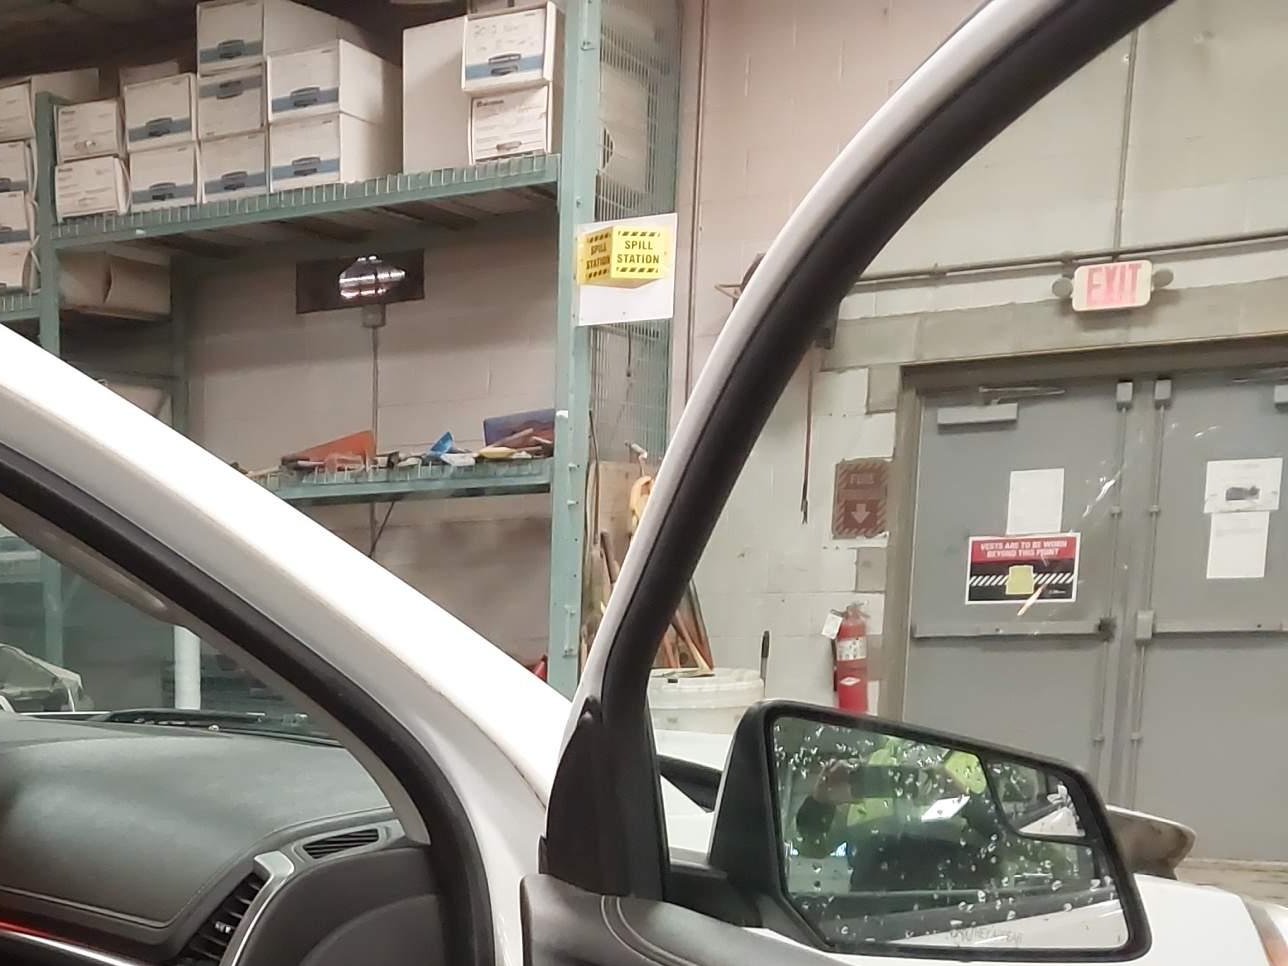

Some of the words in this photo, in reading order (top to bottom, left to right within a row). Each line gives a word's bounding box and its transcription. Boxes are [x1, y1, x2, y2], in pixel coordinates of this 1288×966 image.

[591, 242, 607, 256] SPILL
[624, 240, 653, 250] SPILL
[586, 256, 610, 270] STATION
[616, 253, 660, 264] STATION
[1086, 264, 1142, 305] EXIT
[980, 542, 1003, 550] VESTS
[1005, 541, 1019, 549] ARE
[1021, 541, 1031, 549] TO
